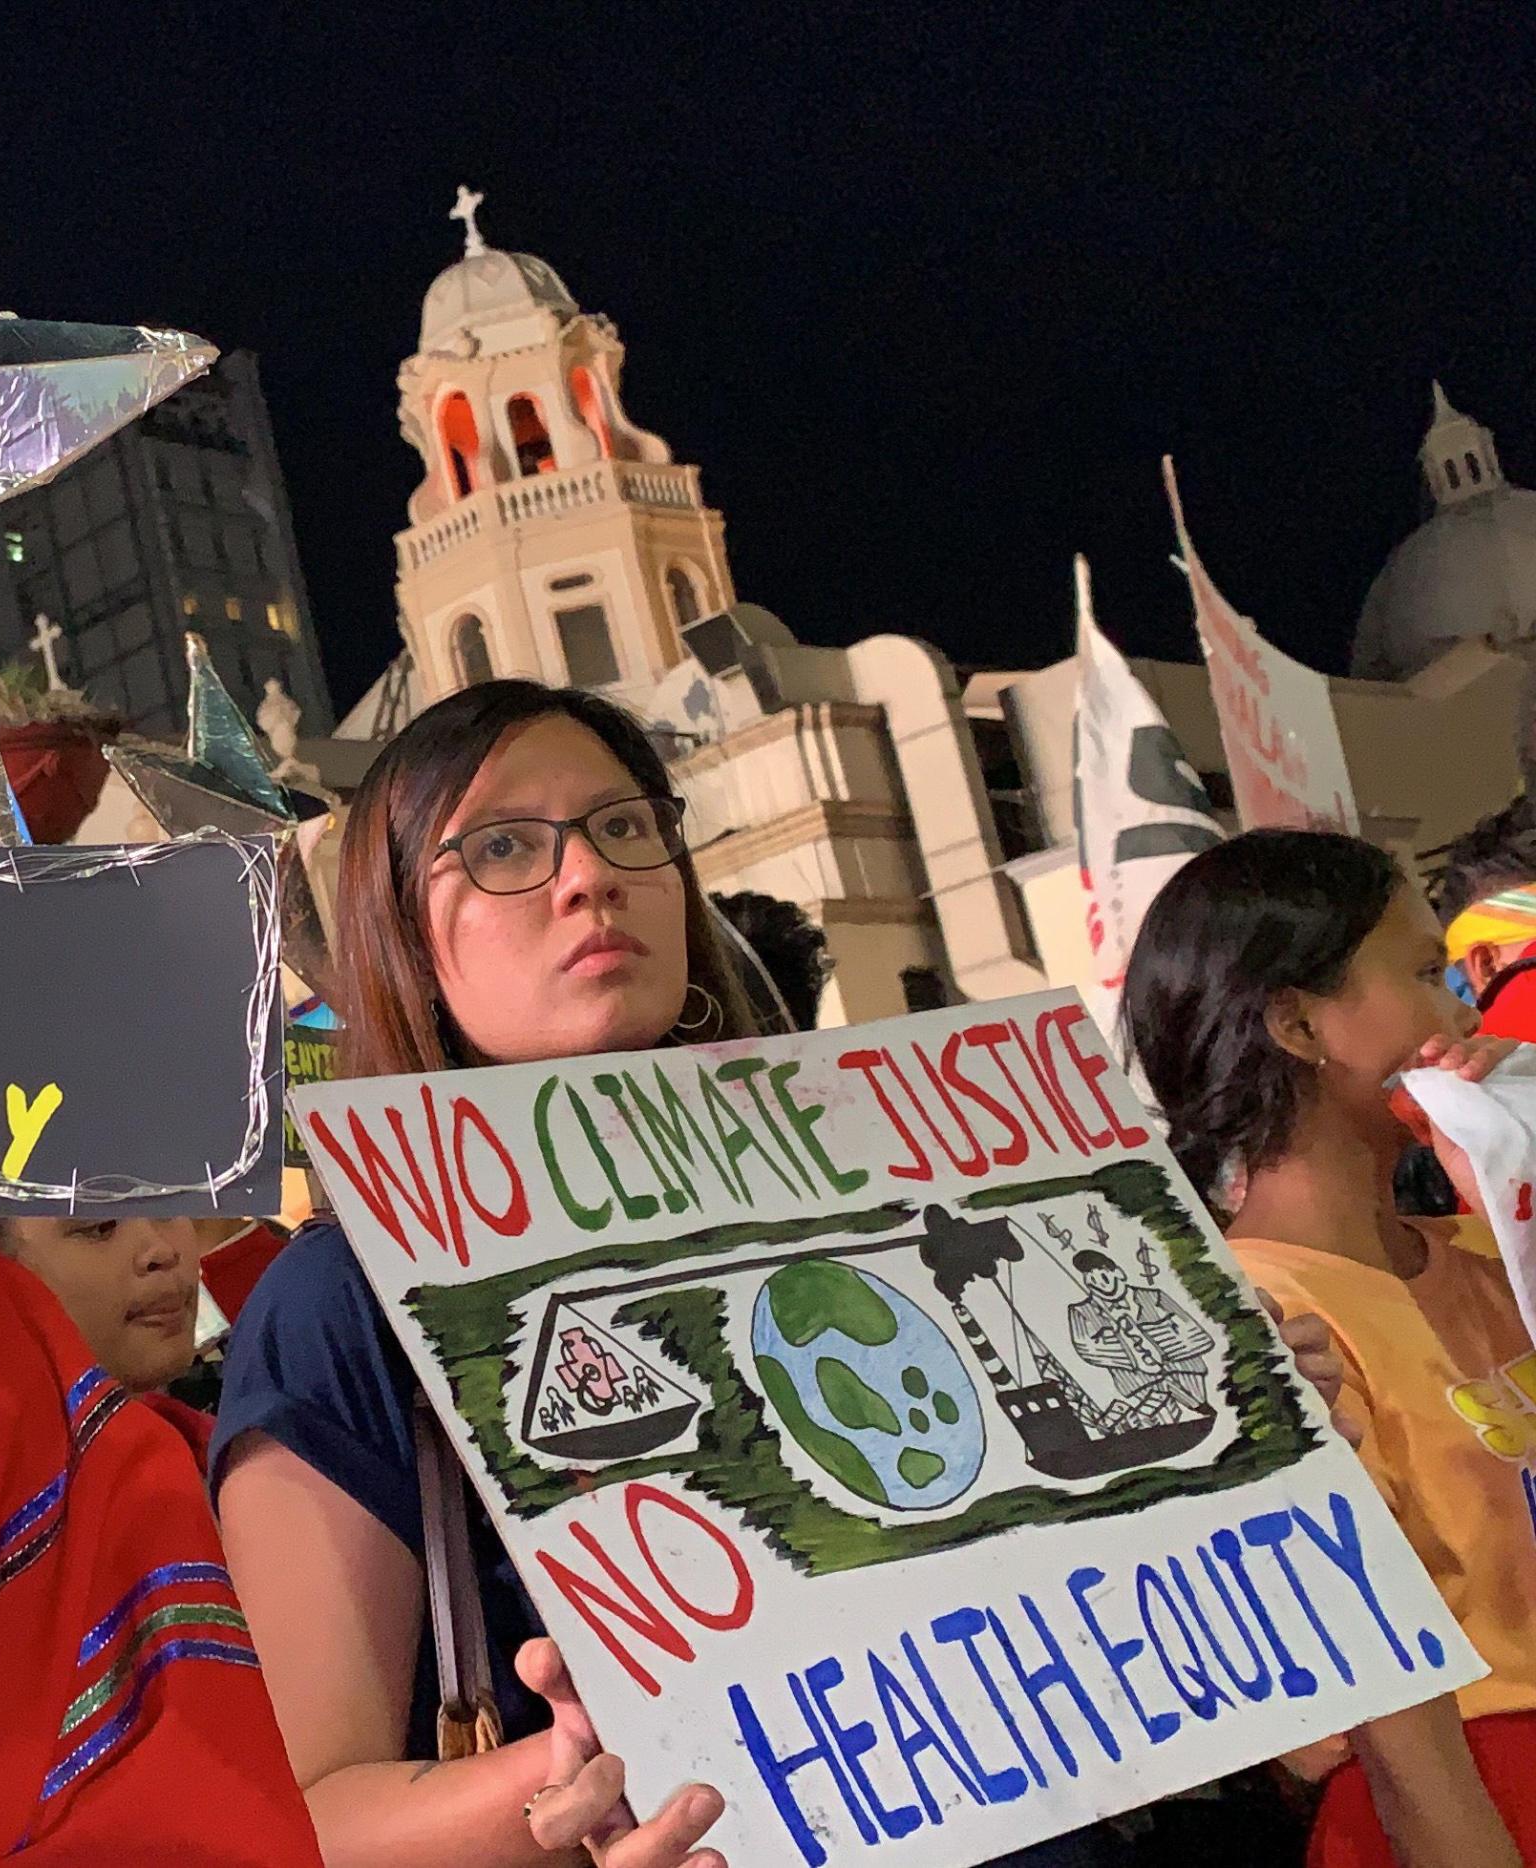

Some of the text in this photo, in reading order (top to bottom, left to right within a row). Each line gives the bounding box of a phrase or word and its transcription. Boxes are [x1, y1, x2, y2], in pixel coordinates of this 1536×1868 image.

[307, 1004, 1150, 1267] W/O CLIMATE JUSTICE
[534, 1482, 755, 1698] NO
[727, 1492, 1446, 1868] HEALTH EQUITY.
